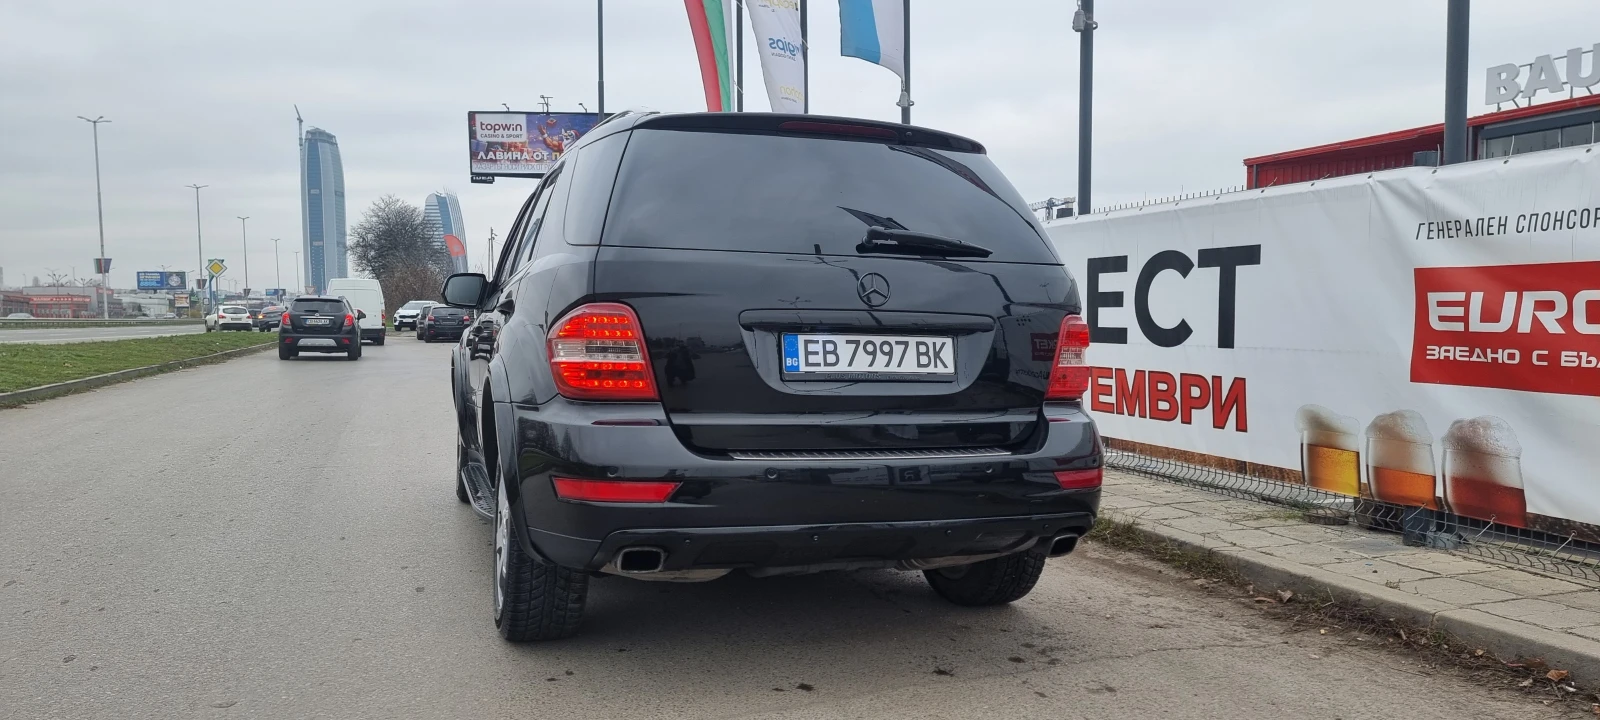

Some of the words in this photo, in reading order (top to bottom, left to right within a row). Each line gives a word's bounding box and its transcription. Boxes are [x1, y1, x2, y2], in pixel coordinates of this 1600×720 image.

[1484, 42, 1600, 105] BAU
[480, 121, 523, 132] topwin
[477, 151, 530, 161] ЛАВИНА
[533, 151, 549, 160] ОТ
[1415, 215, 1509, 240] ГЕНЕРАЛЕН
[786, 357, 798, 366] BG
[803, 339, 840, 367] EB
[845, 339, 910, 368] 7997
[915, 341, 949, 369] BK
[1426, 345, 1520, 364] ЗАЕДНО
[1532, 350, 1549, 366] С
[1088, 365, 1248, 433] ЕМВРИ
